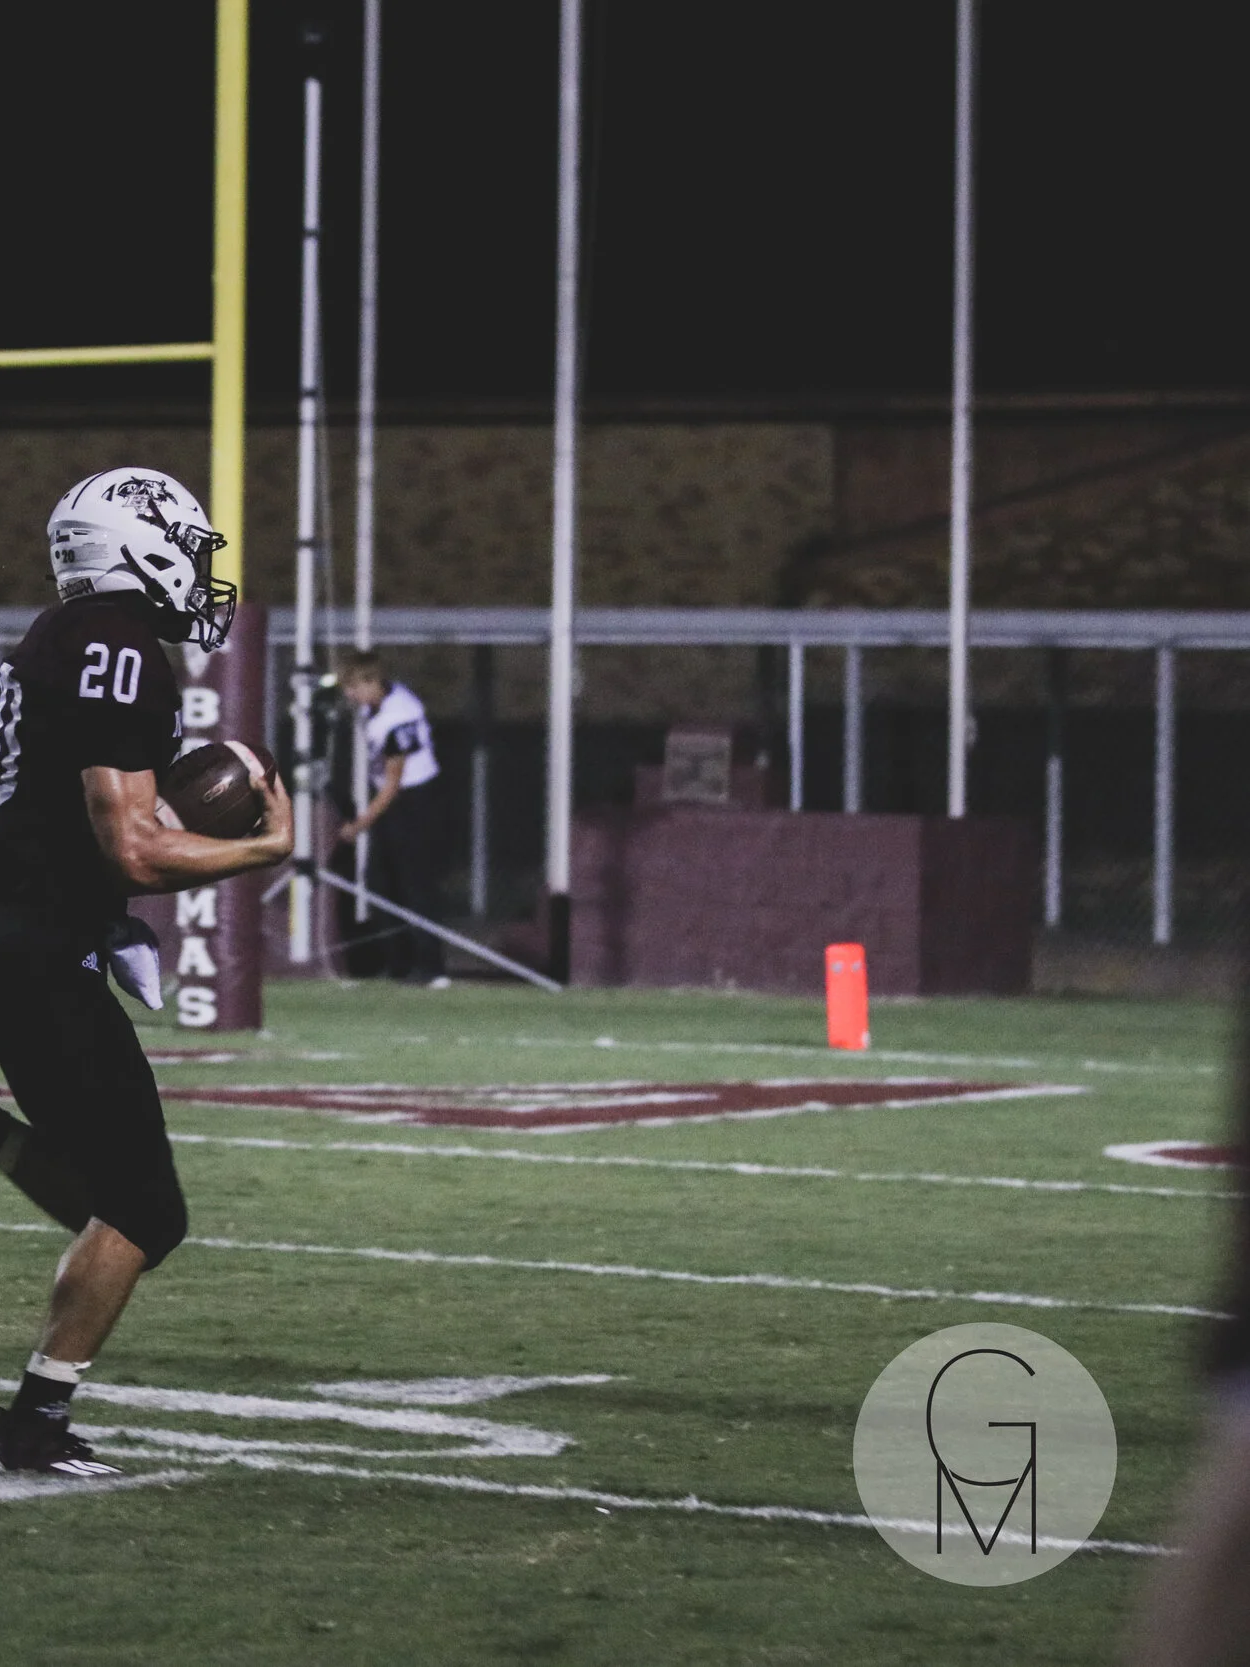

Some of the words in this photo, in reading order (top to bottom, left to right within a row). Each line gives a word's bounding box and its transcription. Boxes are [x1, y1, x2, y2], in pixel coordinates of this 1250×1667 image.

[61, 549, 75, 563] 20
[79, 642, 142, 704] 20
[176, 687, 221, 1028] BMAS
